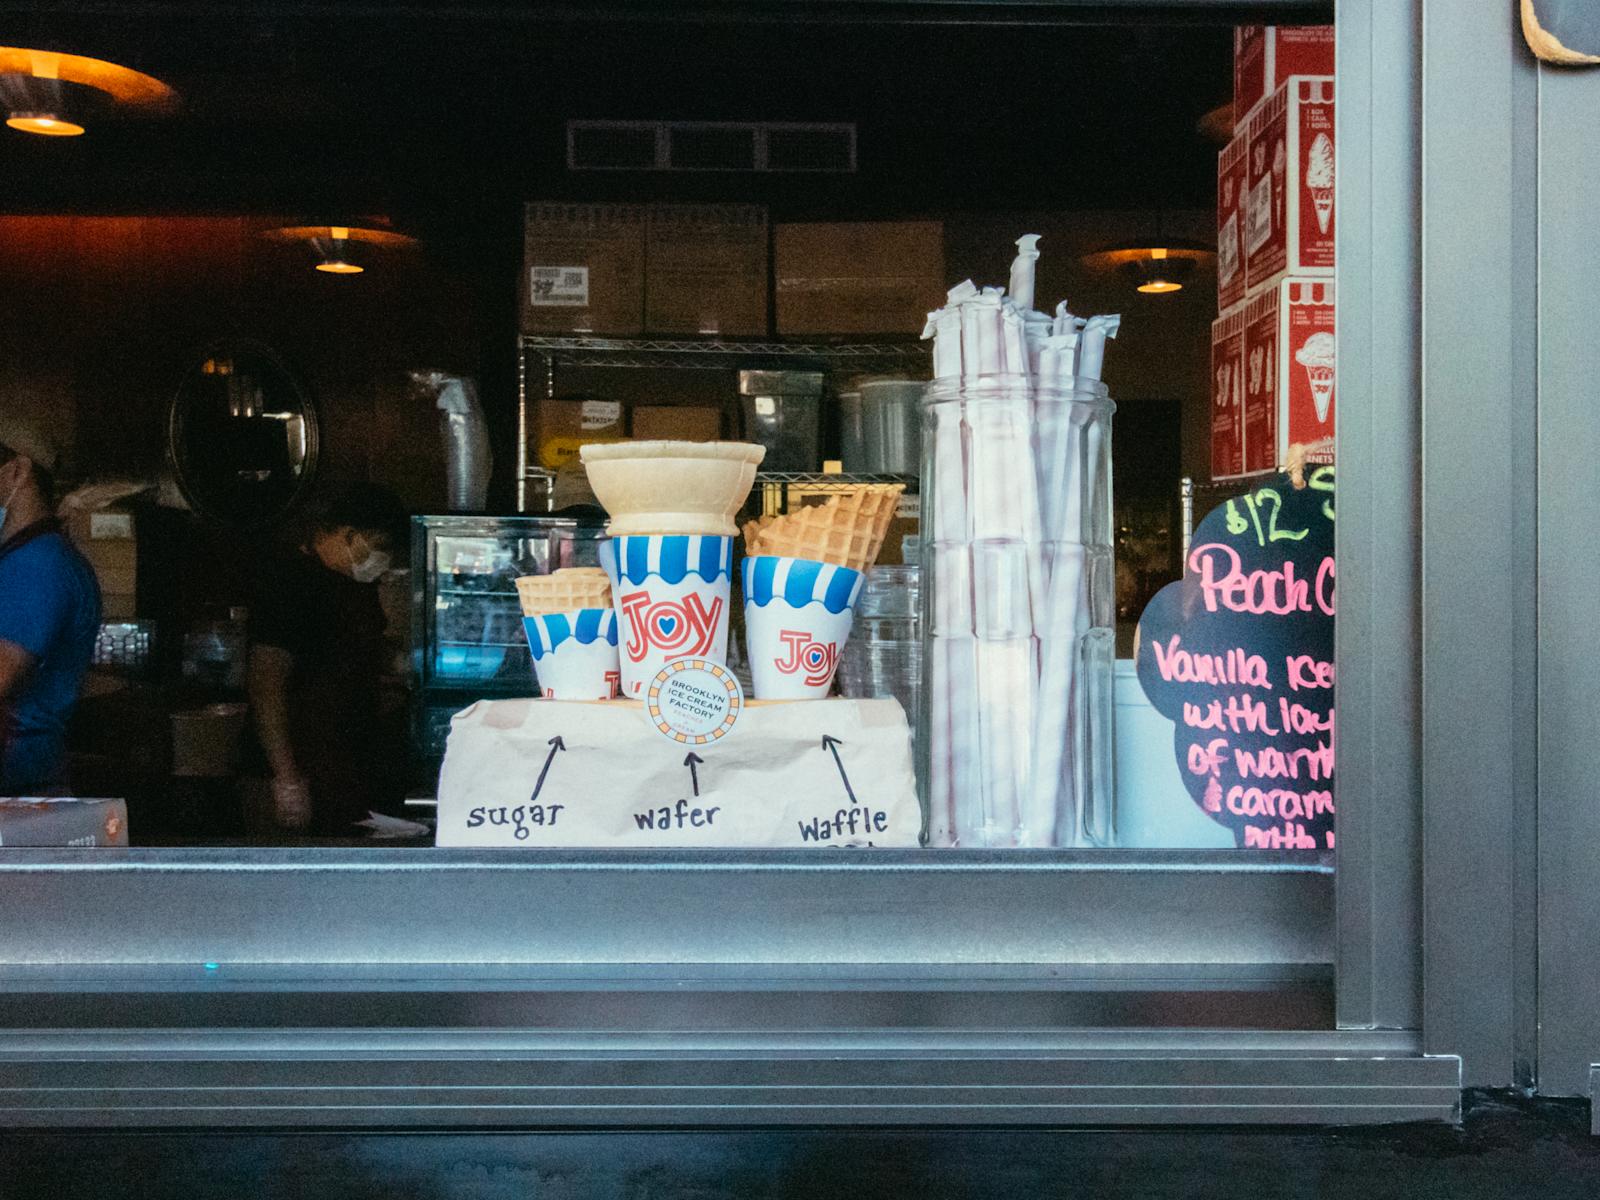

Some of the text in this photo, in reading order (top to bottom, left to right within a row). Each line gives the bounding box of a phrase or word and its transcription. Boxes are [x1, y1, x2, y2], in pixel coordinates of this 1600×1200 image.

[1189, 543, 1312, 615] Peach
[1152, 634, 1272, 689] Vanilla
[668, 688, 722, 712] ICE CREAM
[669, 698, 715, 720] FACTORY
[671, 680, 726, 703] BROOKLYN
[1183, 693, 1279, 736] with
[1187, 738, 1229, 777] of
[467, 804, 565, 840] sugar
[633, 799, 721, 830] wafer
[798, 807, 888, 841] waffle
